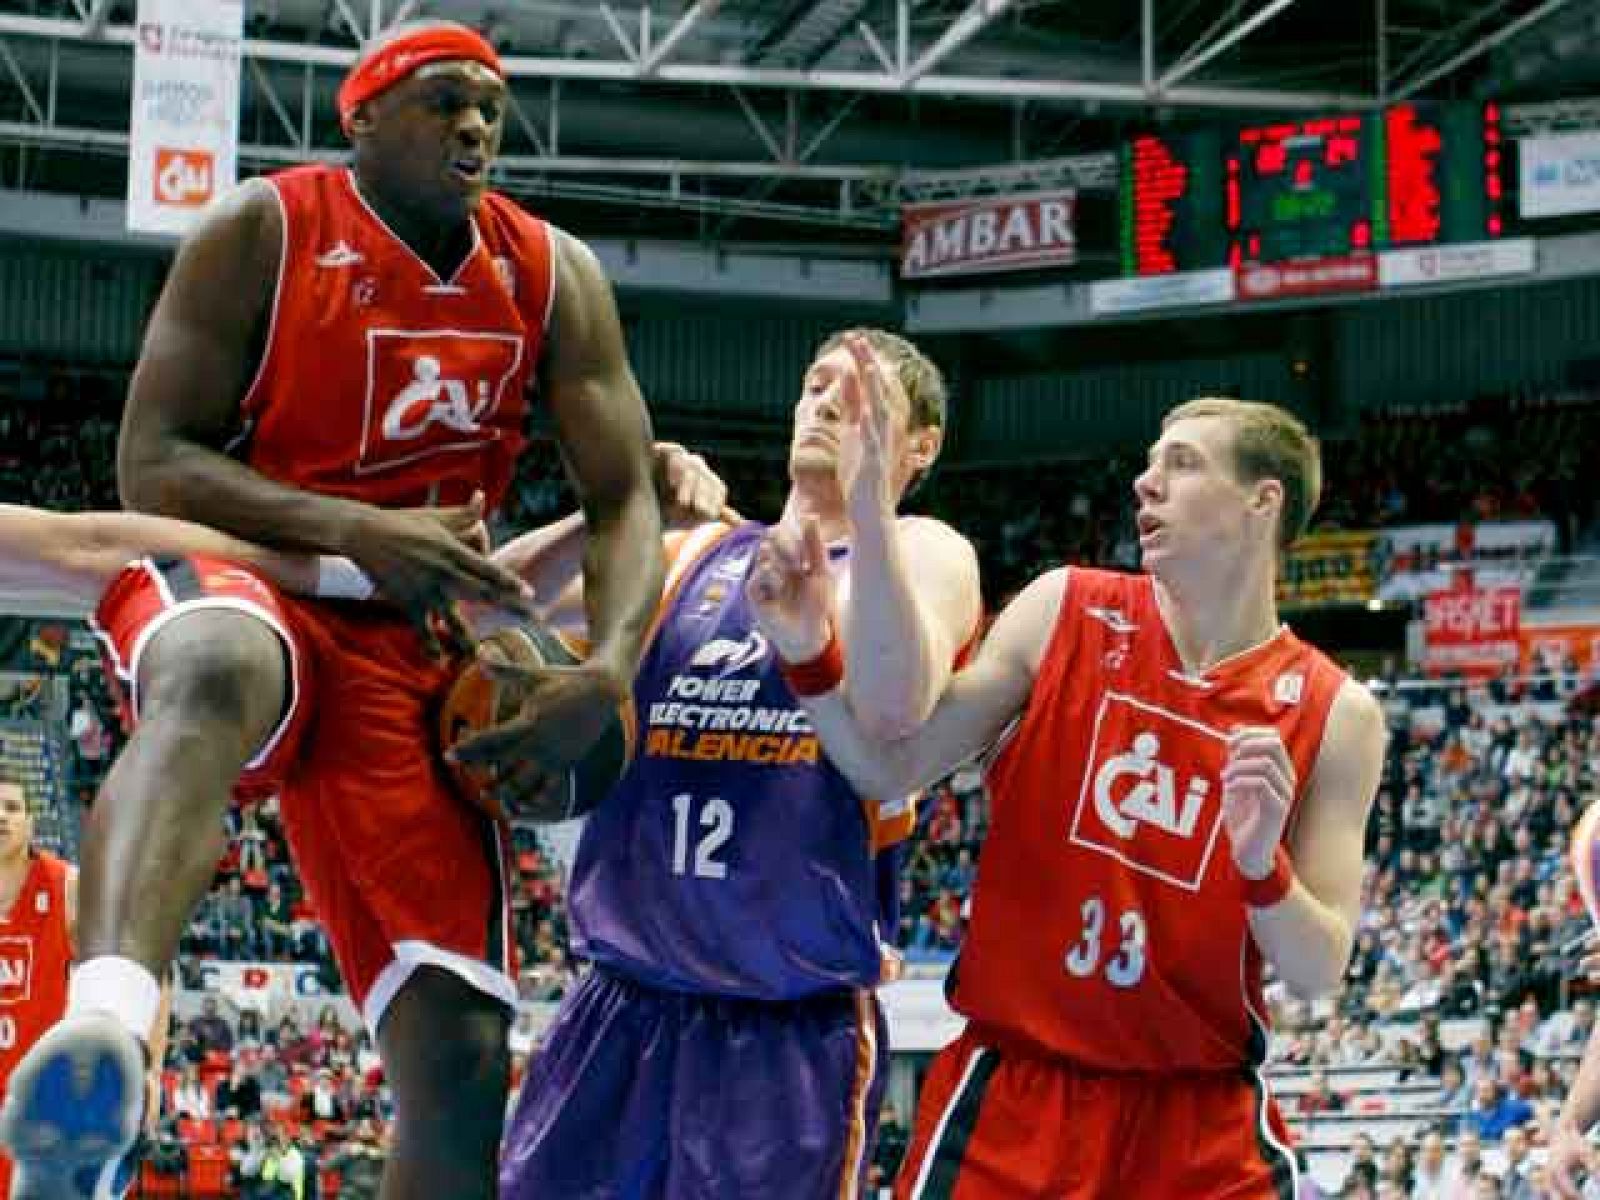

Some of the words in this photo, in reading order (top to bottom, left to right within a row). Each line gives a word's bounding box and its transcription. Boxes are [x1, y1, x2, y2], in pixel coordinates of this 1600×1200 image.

[903, 202, 1076, 277] AMBAR
[672, 793, 736, 878] 12
[1064, 896, 1148, 987] 33
